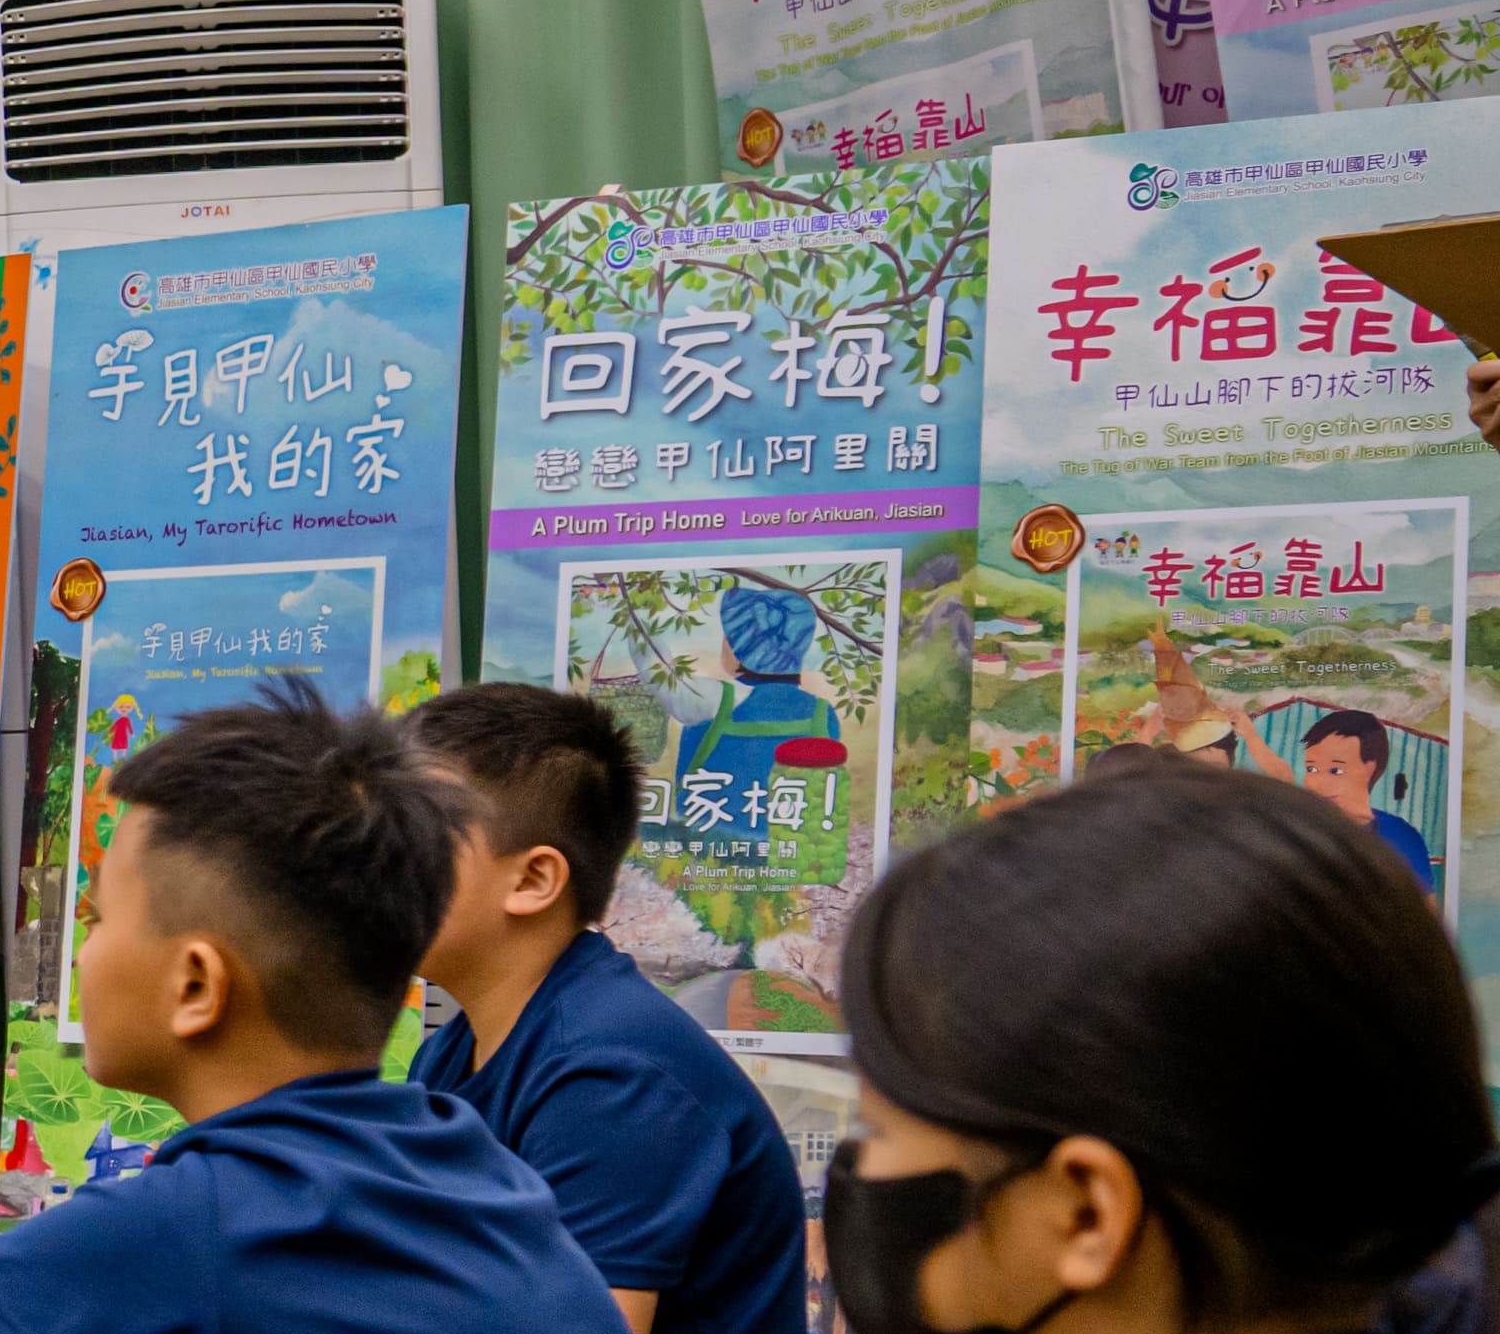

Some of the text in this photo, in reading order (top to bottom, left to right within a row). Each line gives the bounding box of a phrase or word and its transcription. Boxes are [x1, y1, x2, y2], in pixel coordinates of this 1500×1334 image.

[778, 32, 817, 56] The
[746, 126, 774, 147] HOT
[830, 92, 987, 170] 幸福靠山
[1184, 148, 1429, 188] 高雄市甲仙區甲仙國民小學
[1184, 186, 1222, 202] Jiasian
[1226, 181, 1288, 200] Elementary
[1339, 172, 1400, 189] Kaohsiung
[1404, 169, 1428, 185] City
[180, 204, 232, 219] JOTAI
[659, 208, 889, 247] 高雄市甲仙區甲仙國民小學
[157, 253, 377, 296] 高雄市甲仙區甲仙國民小學
[157, 295, 192, 310] Jiasian
[194, 289, 250, 306] Elementary
[295, 280, 350, 296] Kaohsiung
[353, 275, 375, 290] City
[1037, 246, 1461, 380] 幸福靠
[540, 296, 946, 423] 回家梅!
[1114, 365, 1436, 411] 甲仙山腳下的拔河隊
[1098, 411, 1454, 452] The Sweet Togetherness
[187, 413, 406, 506] 我的家
[1060, 460, 1091, 476] The
[1093, 458, 1121, 476] Tug
[1123, 457, 1142, 473] of
[1145, 455, 1174, 472] War
[1178, 453, 1219, 470] Team
[1224, 451, 1260, 467] from
[1263, 450, 1289, 465] the
[1292, 447, 1329, 464] Foot
[1331, 446, 1350, 462] of
[1352, 443, 1410, 461] Jiasian
[80, 508, 398, 547] Jiasian, My Tarorific Hometown
[532, 501, 945, 537] A Plum Trip Home Love for Arikuan, Jiasian
[1029, 527, 1075, 548] HOT
[63, 580, 99, 601] HOT
[1141, 537, 1385, 607] 幸福靠山
[1297, 658, 1398, 678] Togetherness
[683, 865, 797, 880] A Plum Trip Home
